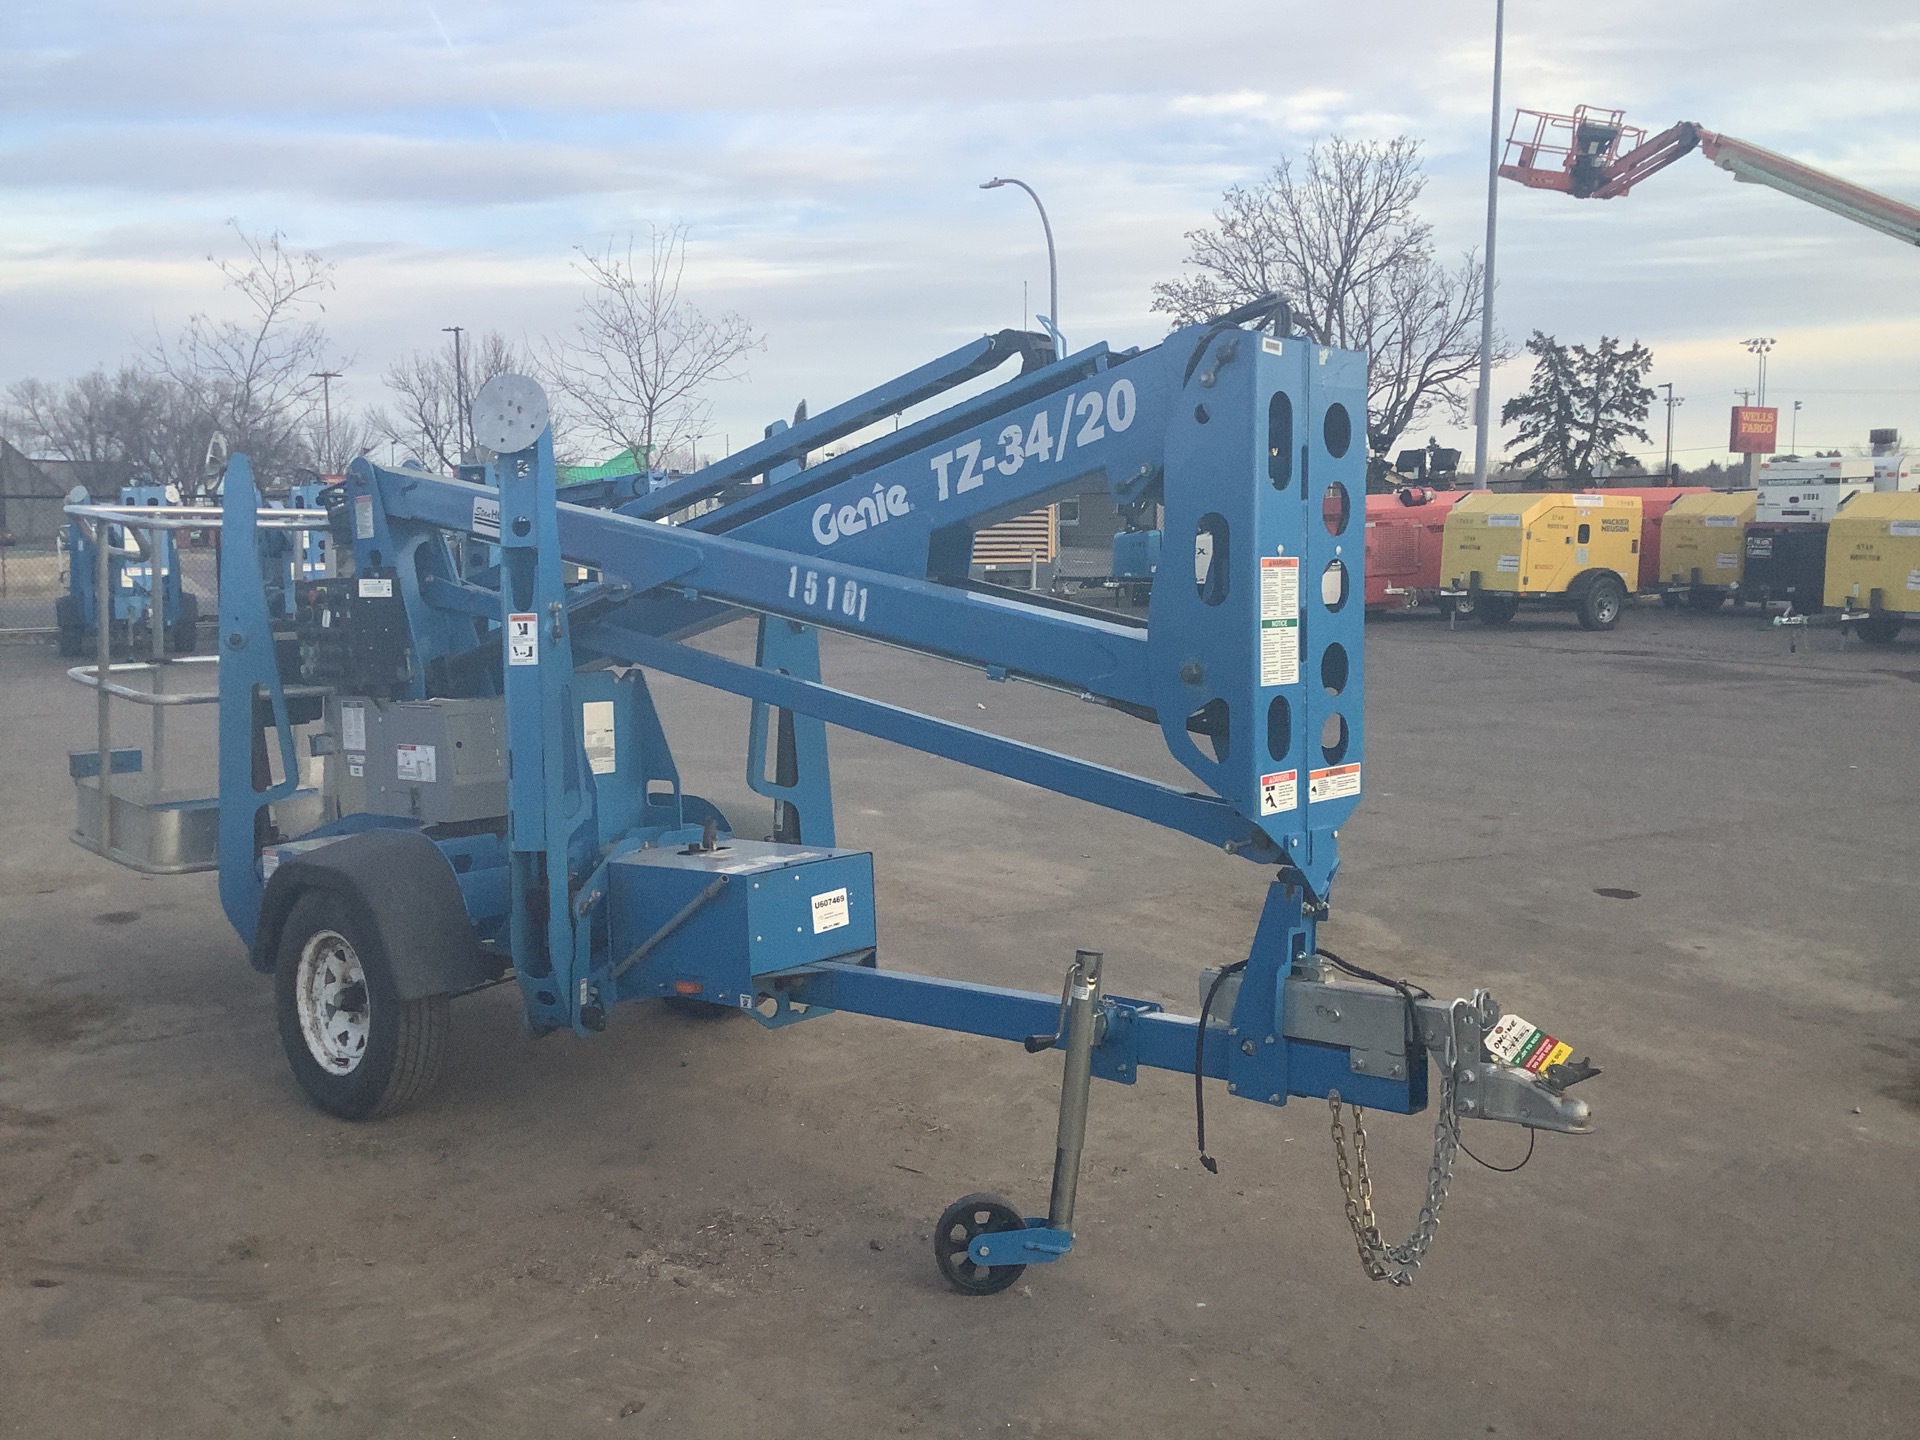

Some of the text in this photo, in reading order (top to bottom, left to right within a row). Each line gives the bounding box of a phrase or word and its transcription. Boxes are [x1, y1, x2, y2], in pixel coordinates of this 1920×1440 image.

[1741, 411, 1774, 422] WELLS
[1741, 422, 1773, 433] FARGO
[930, 378, 1137, 502] TZ-34/20
[812, 482, 910, 546] Genie
[1601, 518, 1630, 526] WACKER
[1601, 525, 1630, 533] NEUSON
[1271, 619, 1288, 628] NOTICE
[1272, 773, 1290, 784] DANGER
[814, 894, 845, 910] U607469
[1554, 1049, 1563, 1060] OUT
